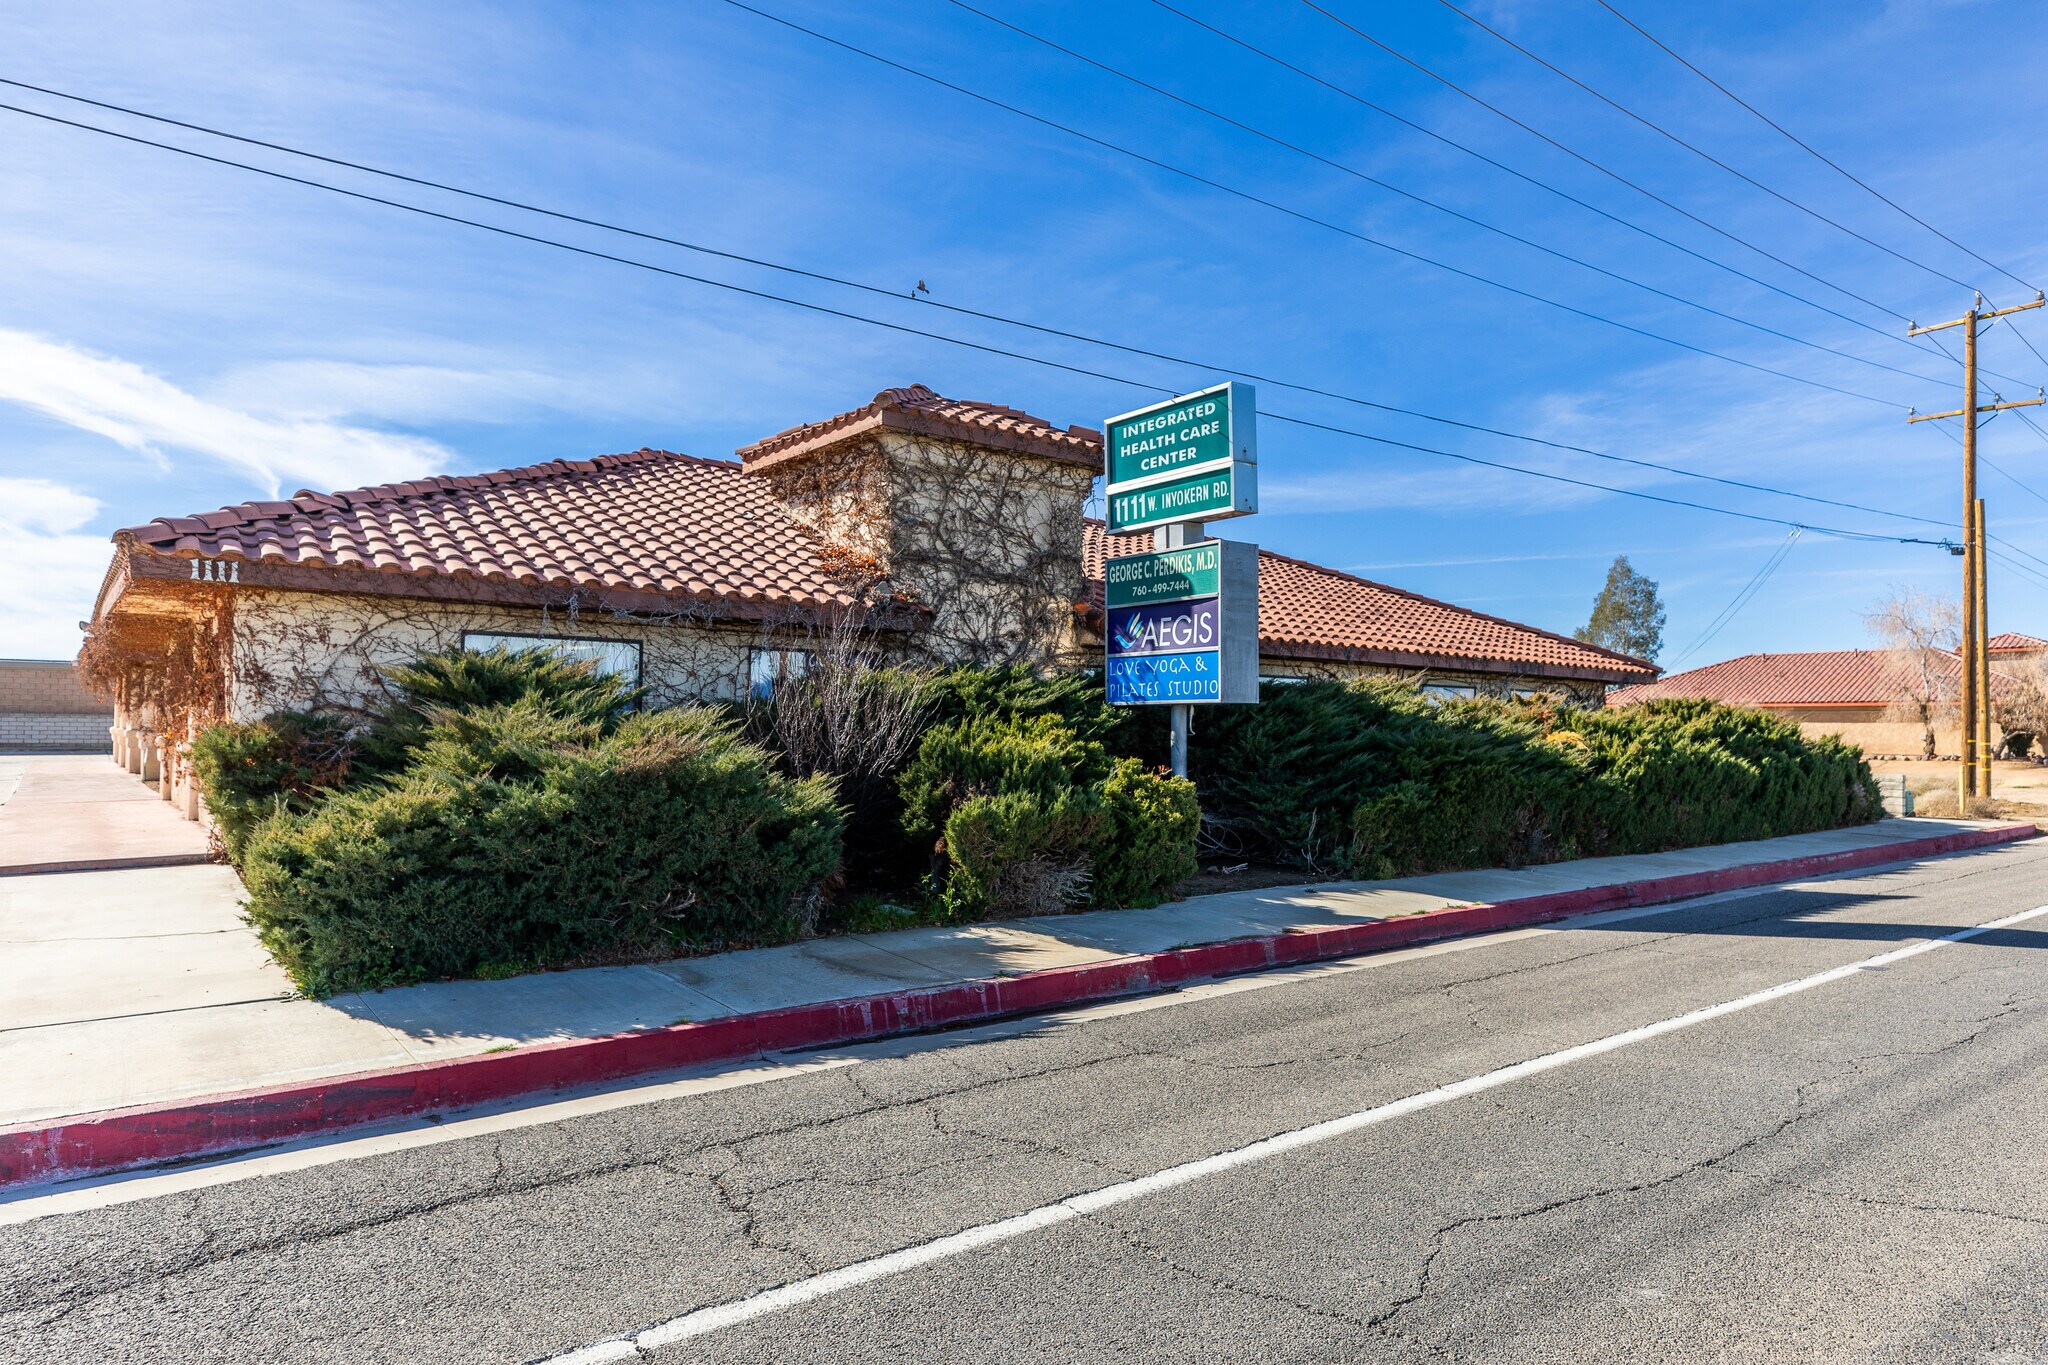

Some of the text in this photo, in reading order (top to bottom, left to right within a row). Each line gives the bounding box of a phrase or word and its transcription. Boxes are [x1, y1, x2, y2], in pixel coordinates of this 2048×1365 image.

[1122, 402, 1216, 439] INTEGRATED
[1120, 421, 1220, 457] HEALTH CARE
[1140, 447, 1197, 470] CENTER
[1114, 480, 1229, 523] 1111 W. INYOKERN RD.
[189, 558, 240, 583] 1111
[1109, 550, 1217, 583] GEORGE C. PERDIKIS, M.D.
[1140, 612, 1213, 649] AEGIS
[1109, 656, 1208, 676] LOVE YOGA &
[1109, 679, 1218, 698] PILATES STUDIO
